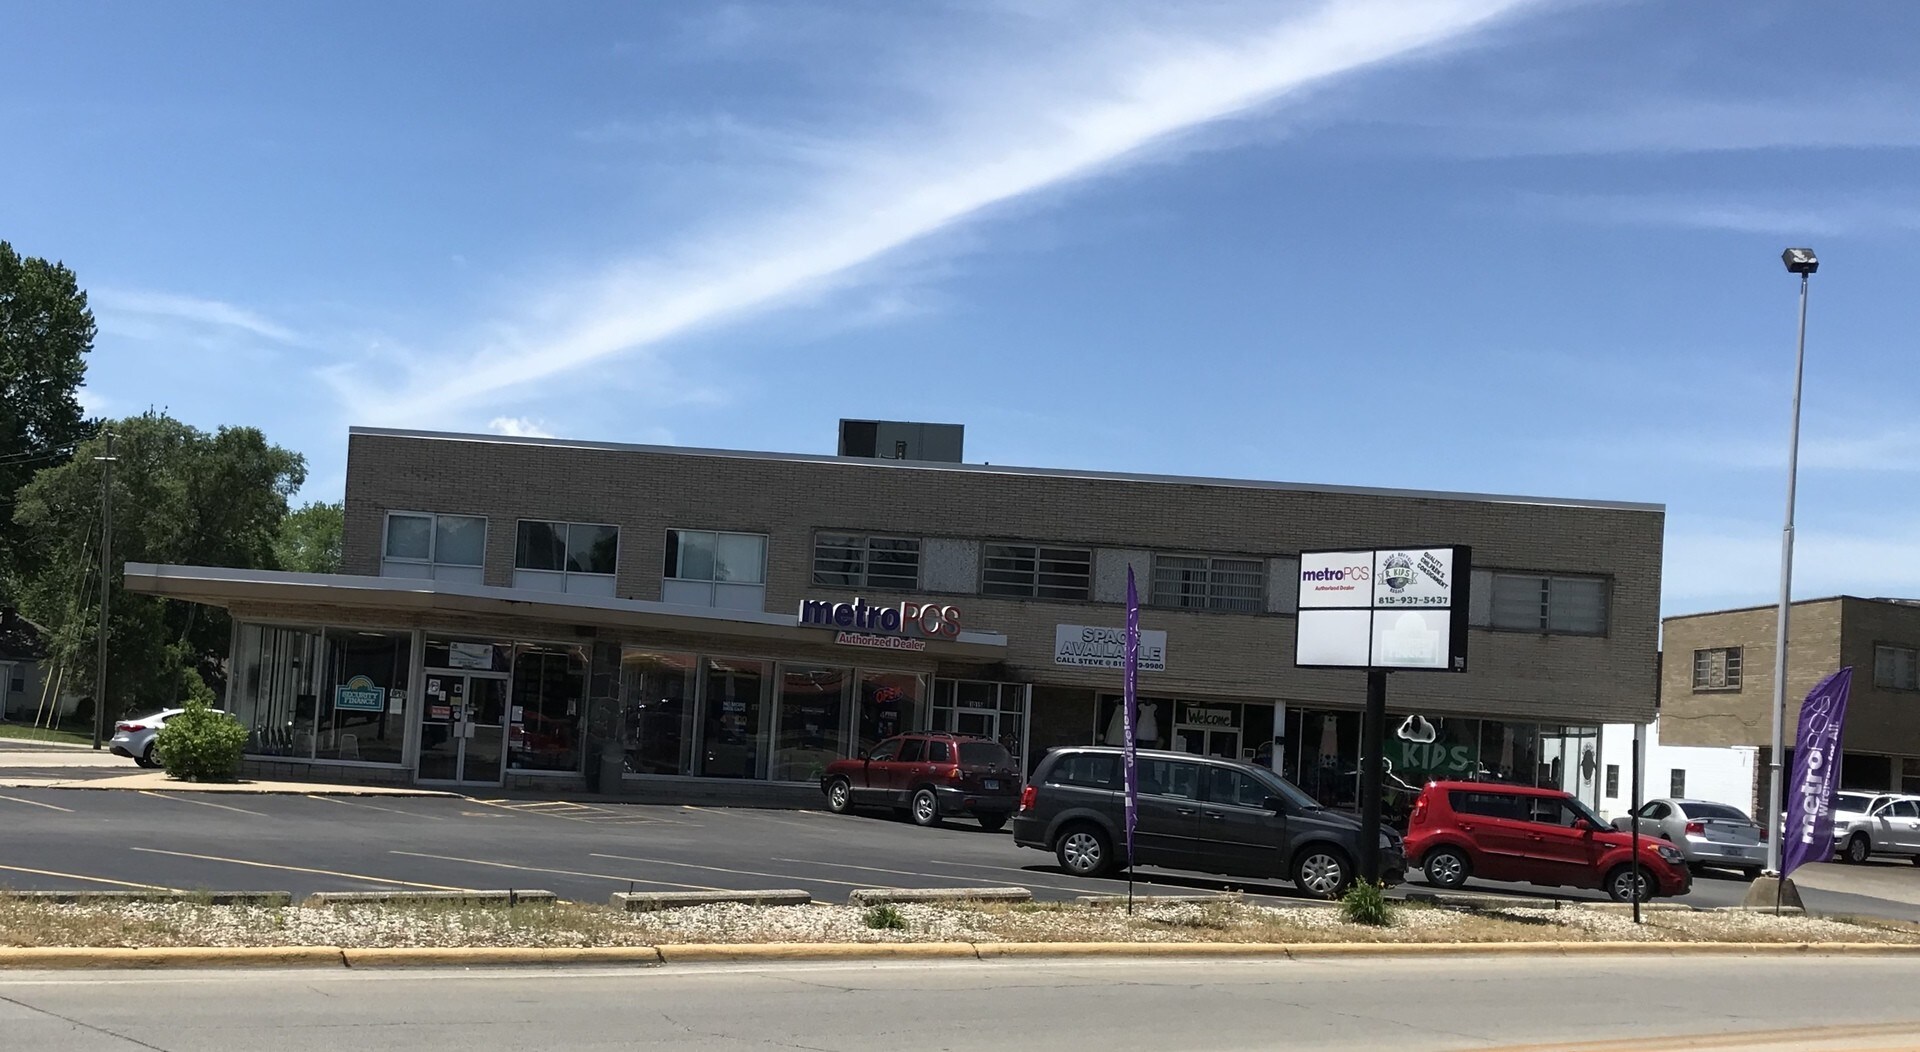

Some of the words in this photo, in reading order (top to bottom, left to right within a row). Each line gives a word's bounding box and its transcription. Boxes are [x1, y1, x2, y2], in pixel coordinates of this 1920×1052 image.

[1424, 551, 1443, 569] QUALITY
[1302, 566, 1369, 581] metroPCS
[1385, 570, 1391, 578] R
[1393, 568, 1411, 577] KIDS
[1417, 562, 1448, 590] CONSIGNMENT
[1378, 596, 1448, 604] 815-937-5437
[799, 597, 961, 637] metroPCS
[838, 633, 892, 648] Authorized
[892, 638, 925, 651] Dealer
[1060, 640, 1161, 662] AVAILALE
[1056, 656, 1076, 664] CALL
[1078, 658, 1104, 666] STEVE
[341, 690, 379, 699] SECURITY
[344, 697, 376, 705] FINANCE
[1188, 709, 1231, 727] Welcome
[1402, 742, 1469, 772] KIDS
[1800, 695, 1831, 845] metroPCS
